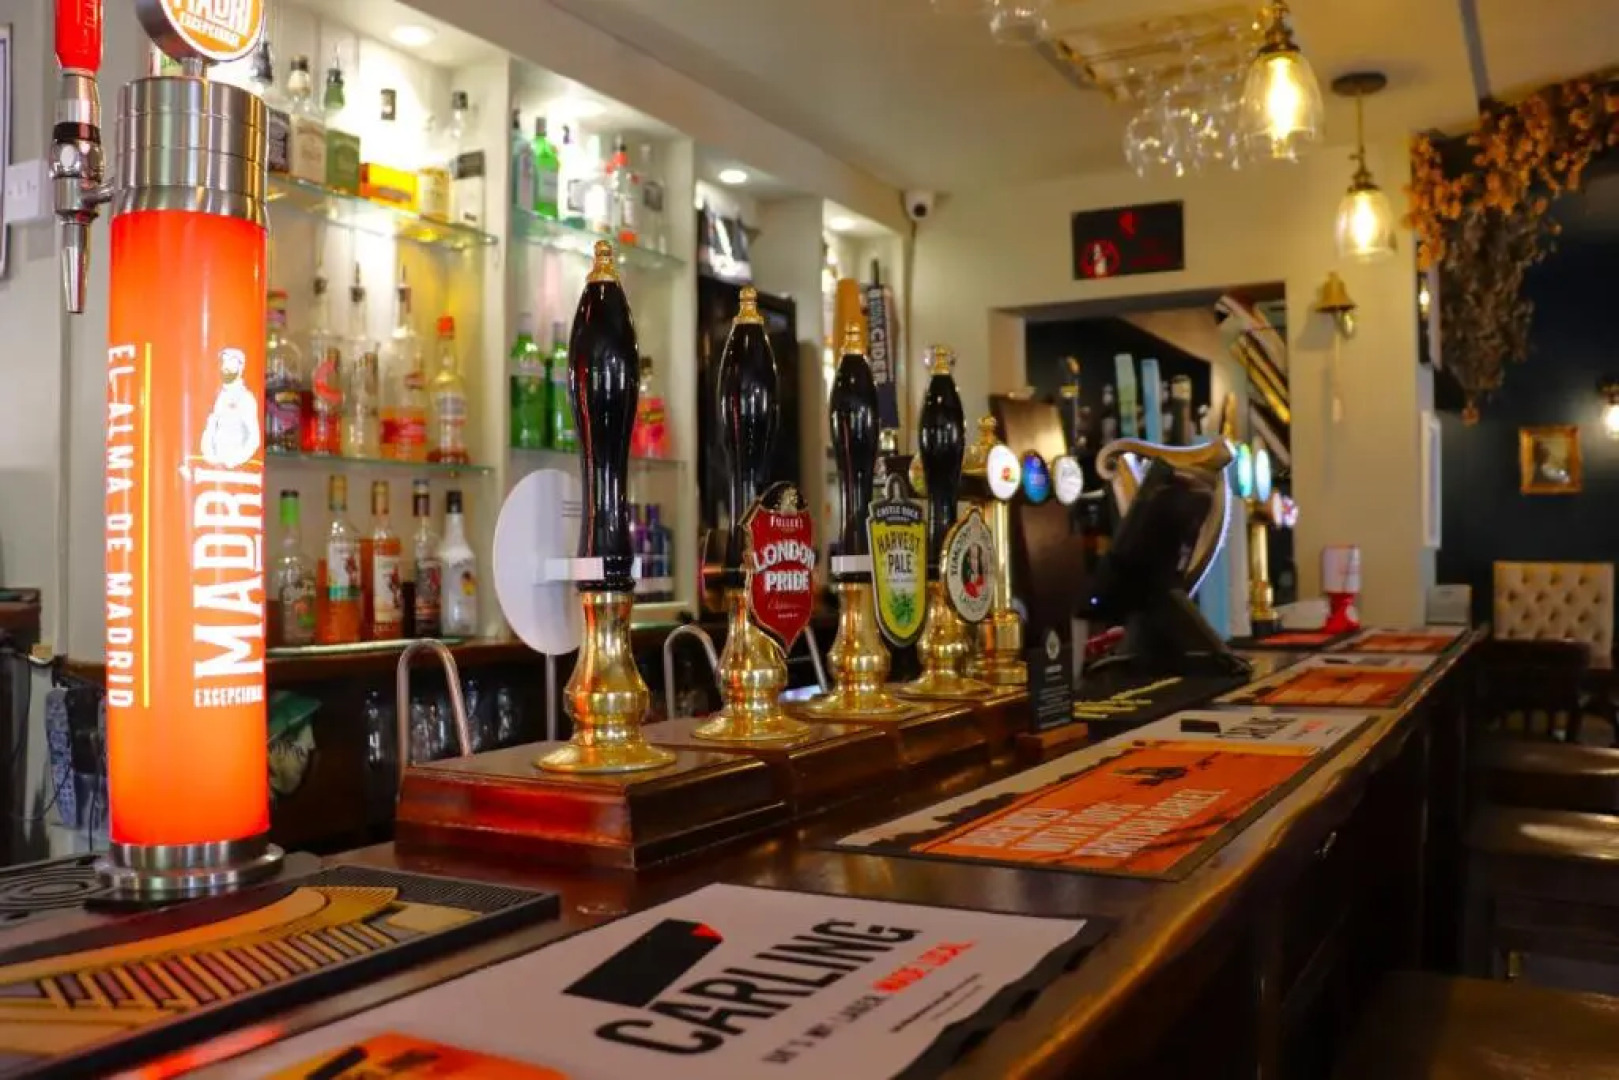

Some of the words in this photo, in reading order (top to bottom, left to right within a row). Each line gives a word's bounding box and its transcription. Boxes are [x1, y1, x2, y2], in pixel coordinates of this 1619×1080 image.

[107, 344, 136, 393] EL
[107, 402, 134, 494] ALMA
[107, 513, 134, 553] DE
[877, 530, 921, 554] HARVEST
[753, 539, 816, 572] LONDON
[888, 553, 914, 574] PALE
[764, 570, 809, 593] PRIDE
[107, 572, 134, 708] MADRID
[594, 918, 923, 1056] CARLING
